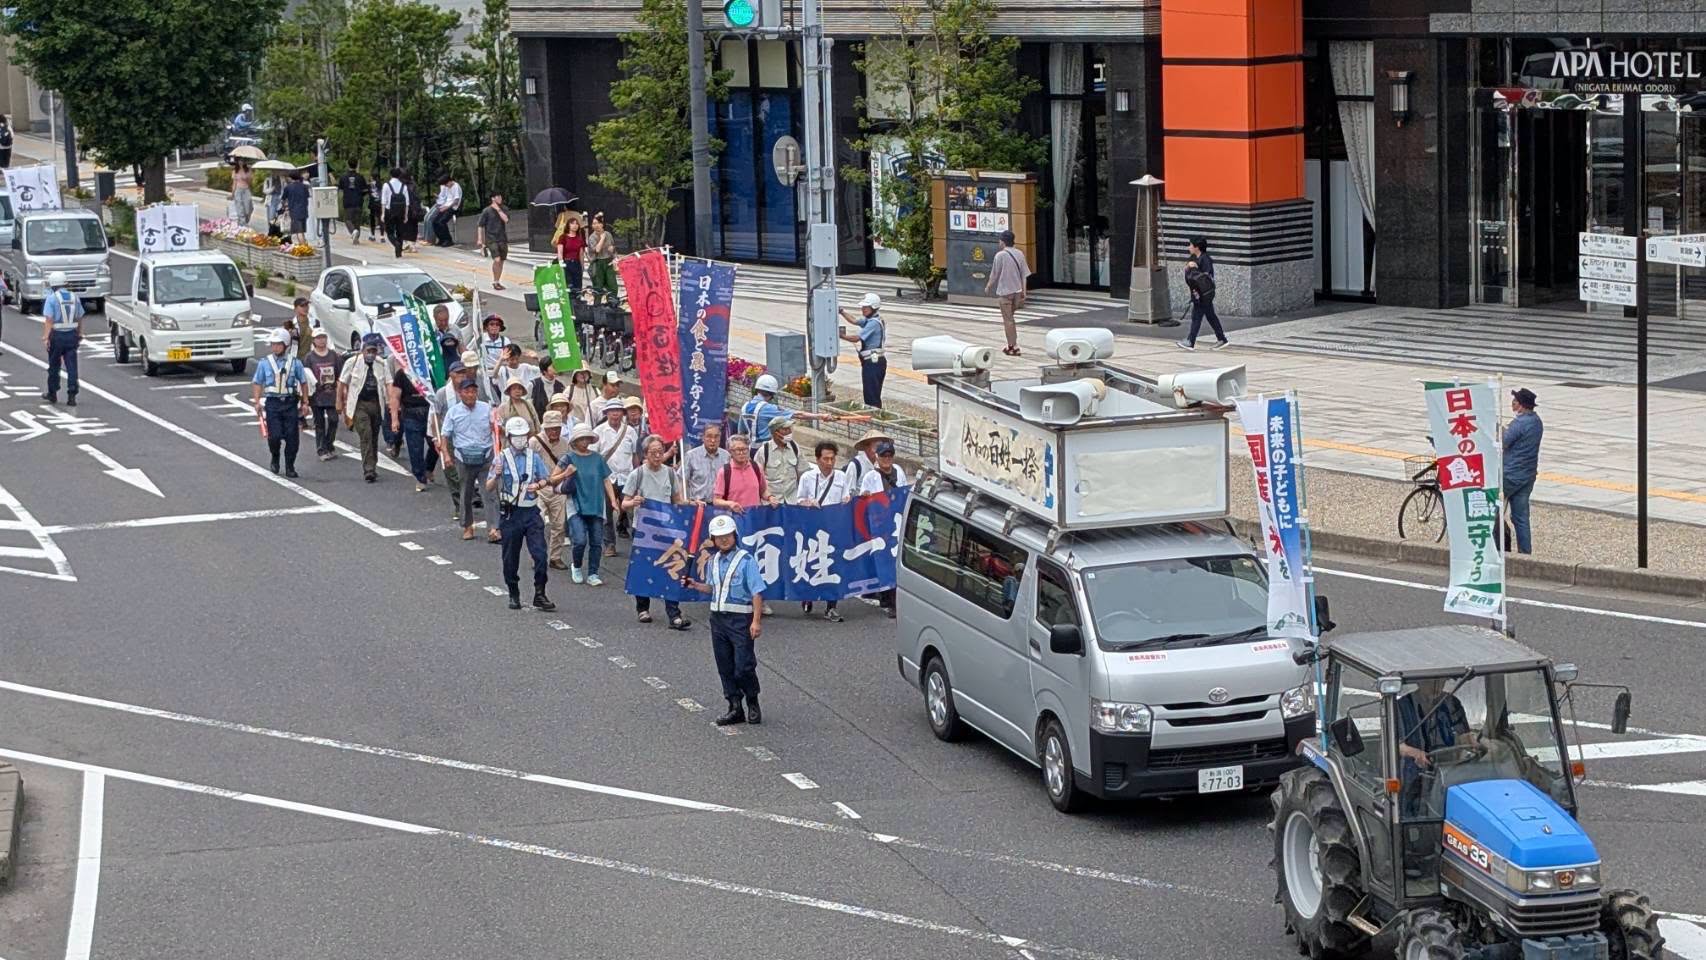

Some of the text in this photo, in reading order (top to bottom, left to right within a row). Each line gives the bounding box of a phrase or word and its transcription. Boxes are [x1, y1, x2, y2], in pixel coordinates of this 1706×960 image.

[1610, 51, 1702, 78] HOTEL
[541, 282, 571, 360] 農協労連
[689, 275, 713, 427] 日本の食と農を守ろう
[963, 423, 1040, 484] 令和の百姓一揆
[1269, 415, 1293, 530] 未来の子どもに
[1208, 775, 1241, 791] 77-03
[1447, 833, 1488, 869] GEAS 33
